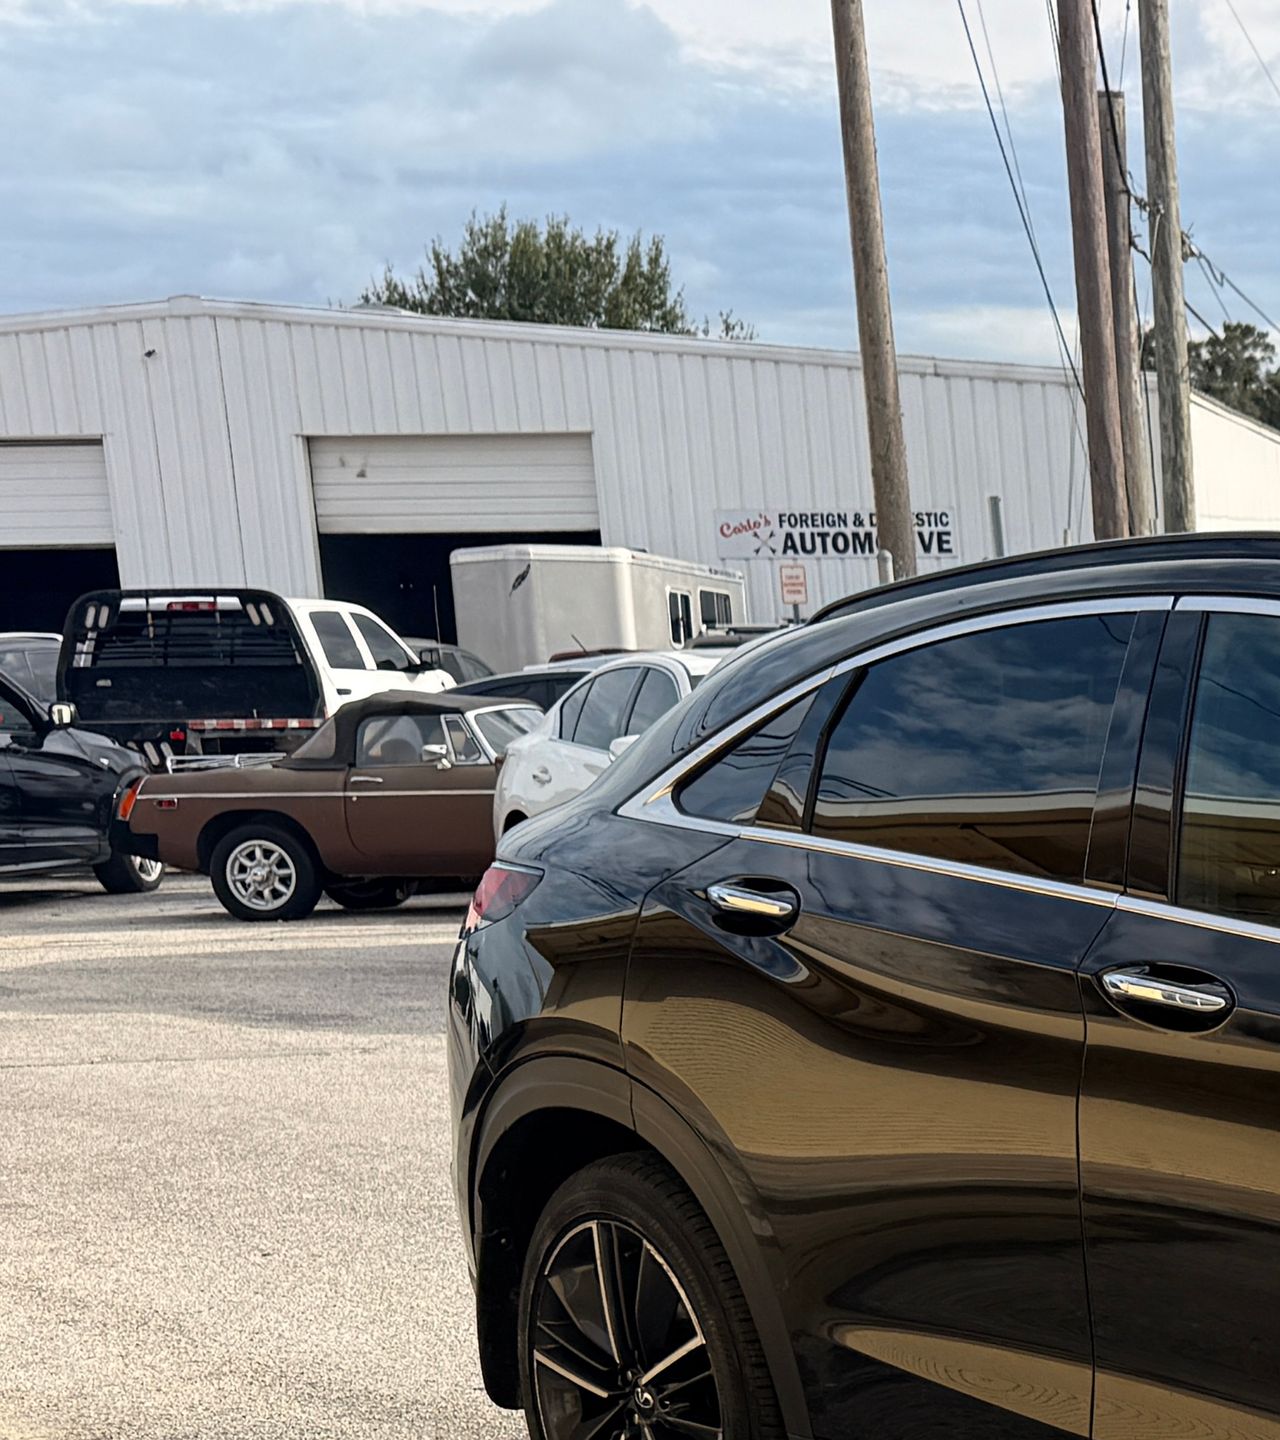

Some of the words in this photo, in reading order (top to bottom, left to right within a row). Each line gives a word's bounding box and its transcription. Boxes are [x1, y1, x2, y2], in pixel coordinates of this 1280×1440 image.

[778, 513, 847, 528] FOREIGN
[853, 512, 865, 528] &
[869, 512, 949, 528] DSTIC
[782, 532, 953, 555] AUTOMVE
